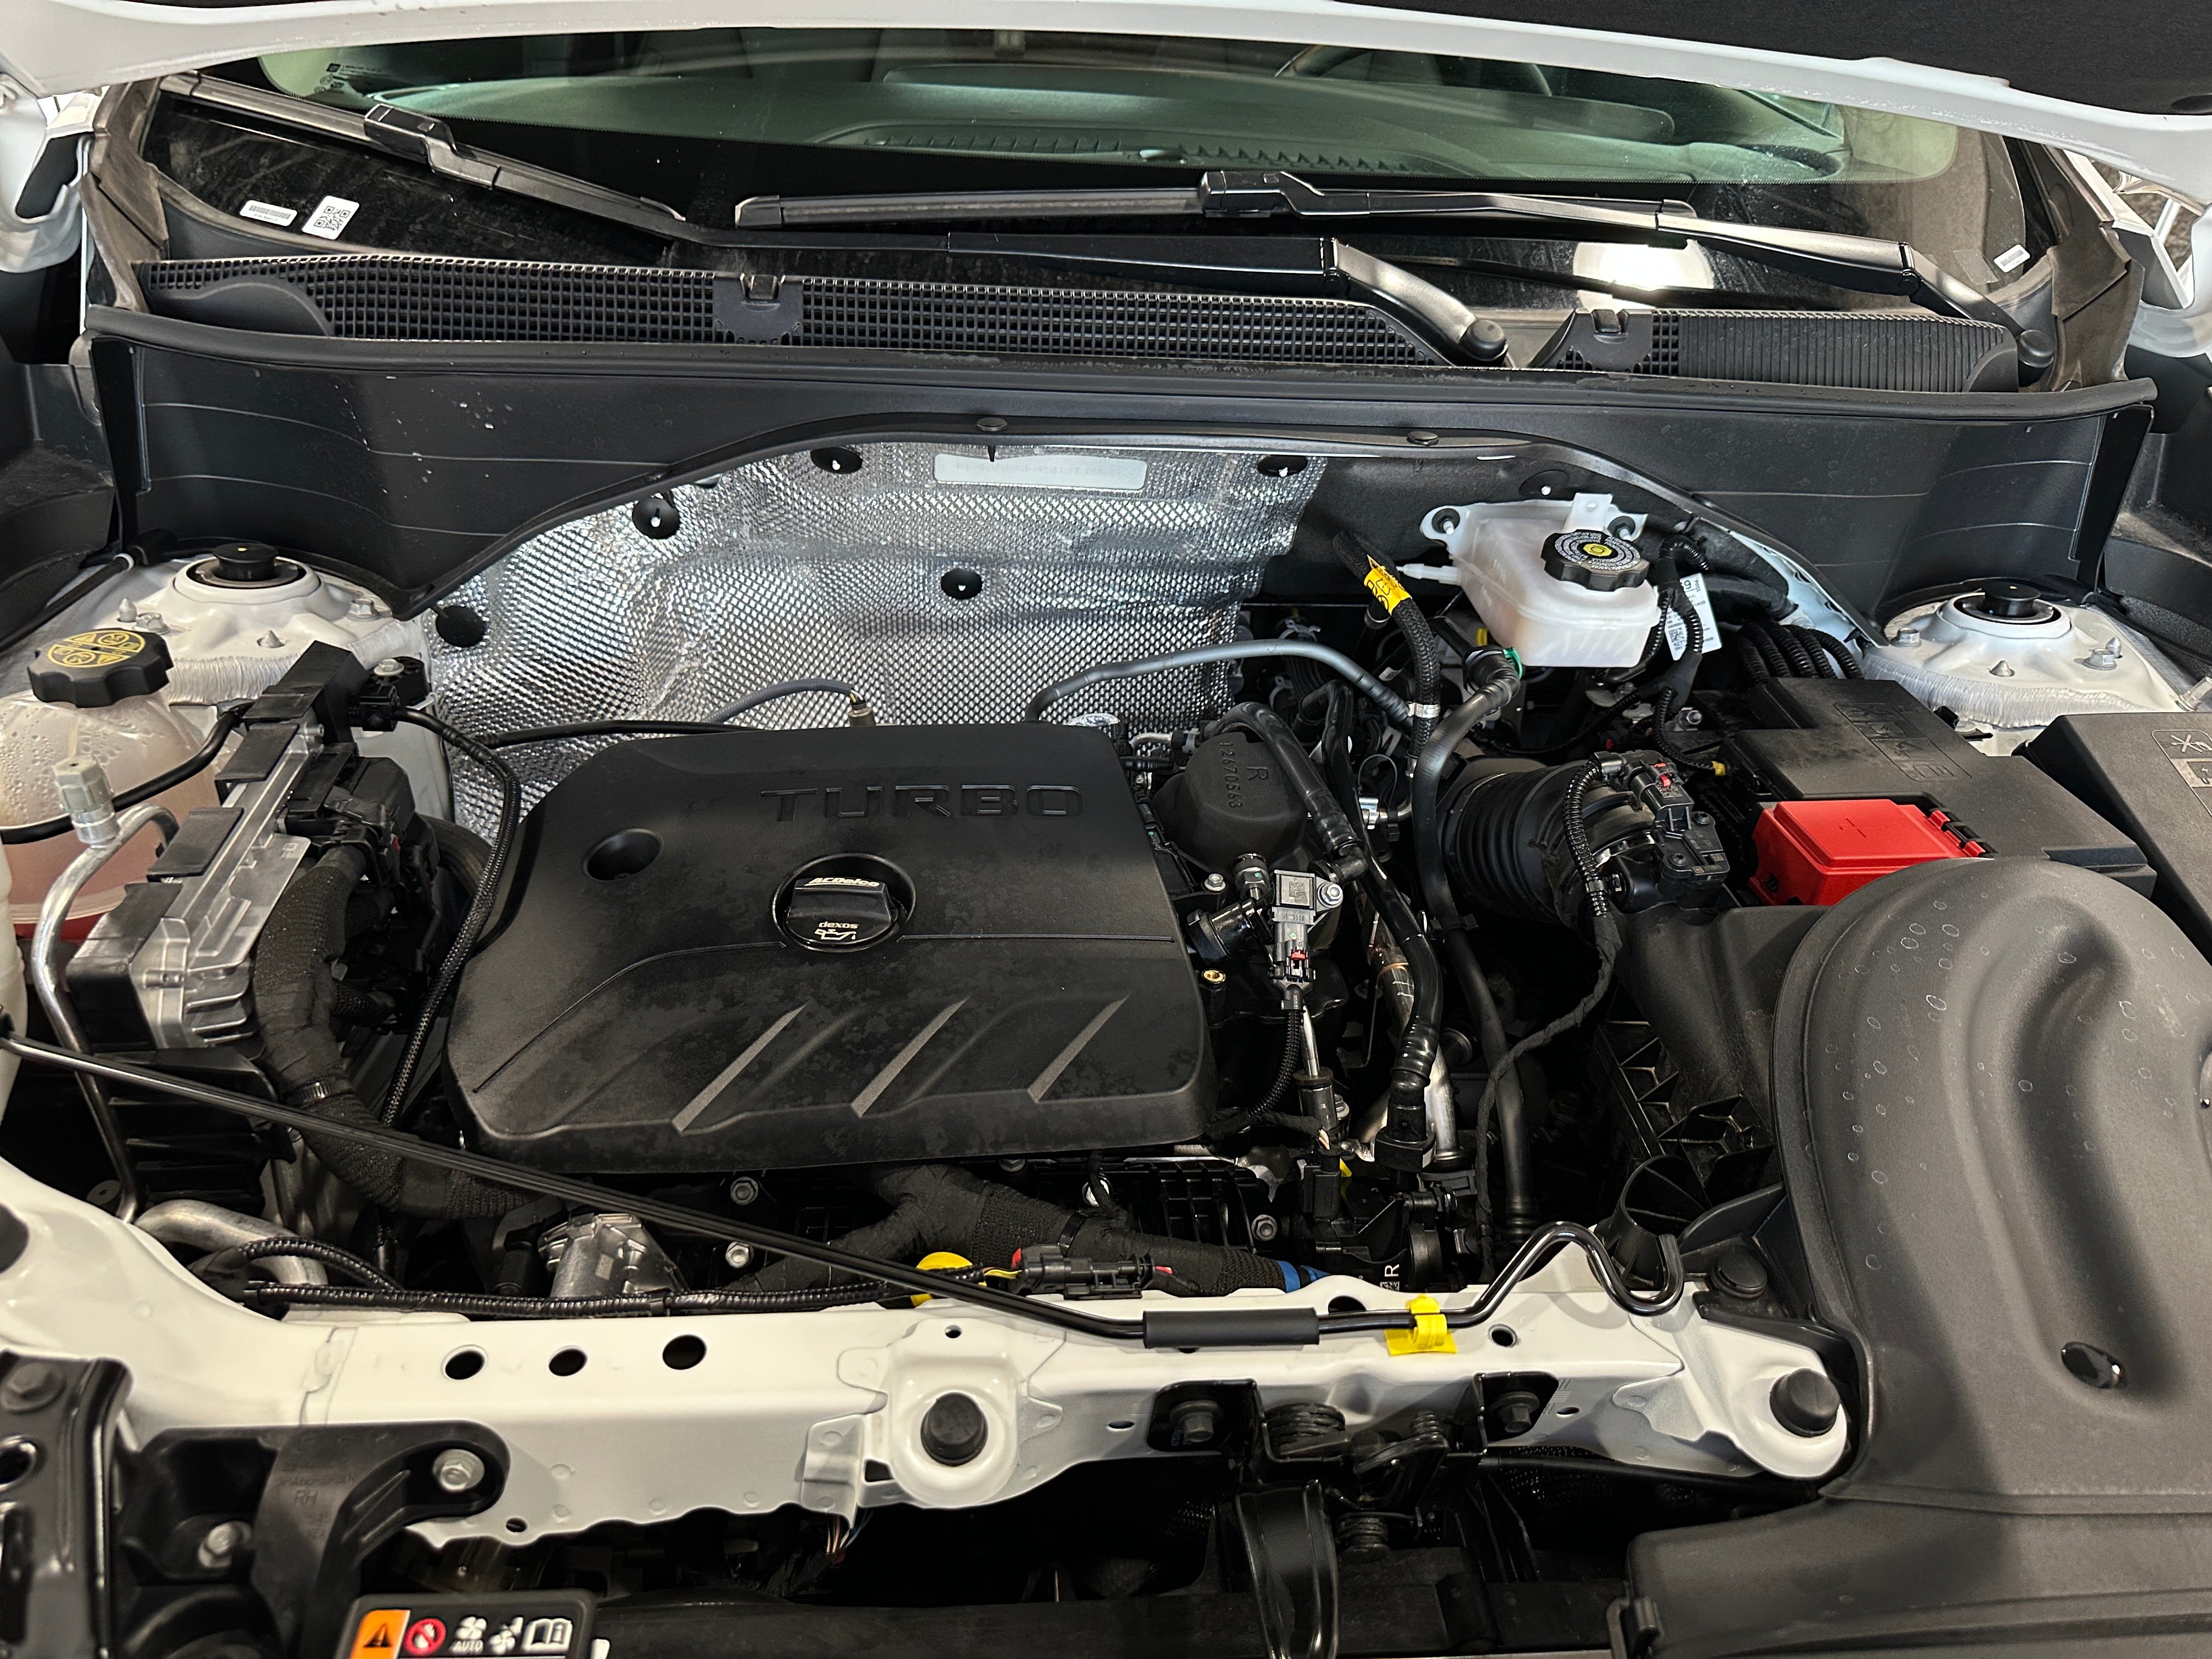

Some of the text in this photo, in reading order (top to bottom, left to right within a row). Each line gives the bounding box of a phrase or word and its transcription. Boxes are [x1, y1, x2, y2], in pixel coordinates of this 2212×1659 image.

[1220, 742, 1243, 808] 12670563
[1246, 766, 1269, 781] R
[760, 785, 1083, 821] TURBO
[808, 877, 880, 887] ACDelco
[1384, 1264, 1400, 1277] R
[450, 1640, 483, 1652] AUTO
